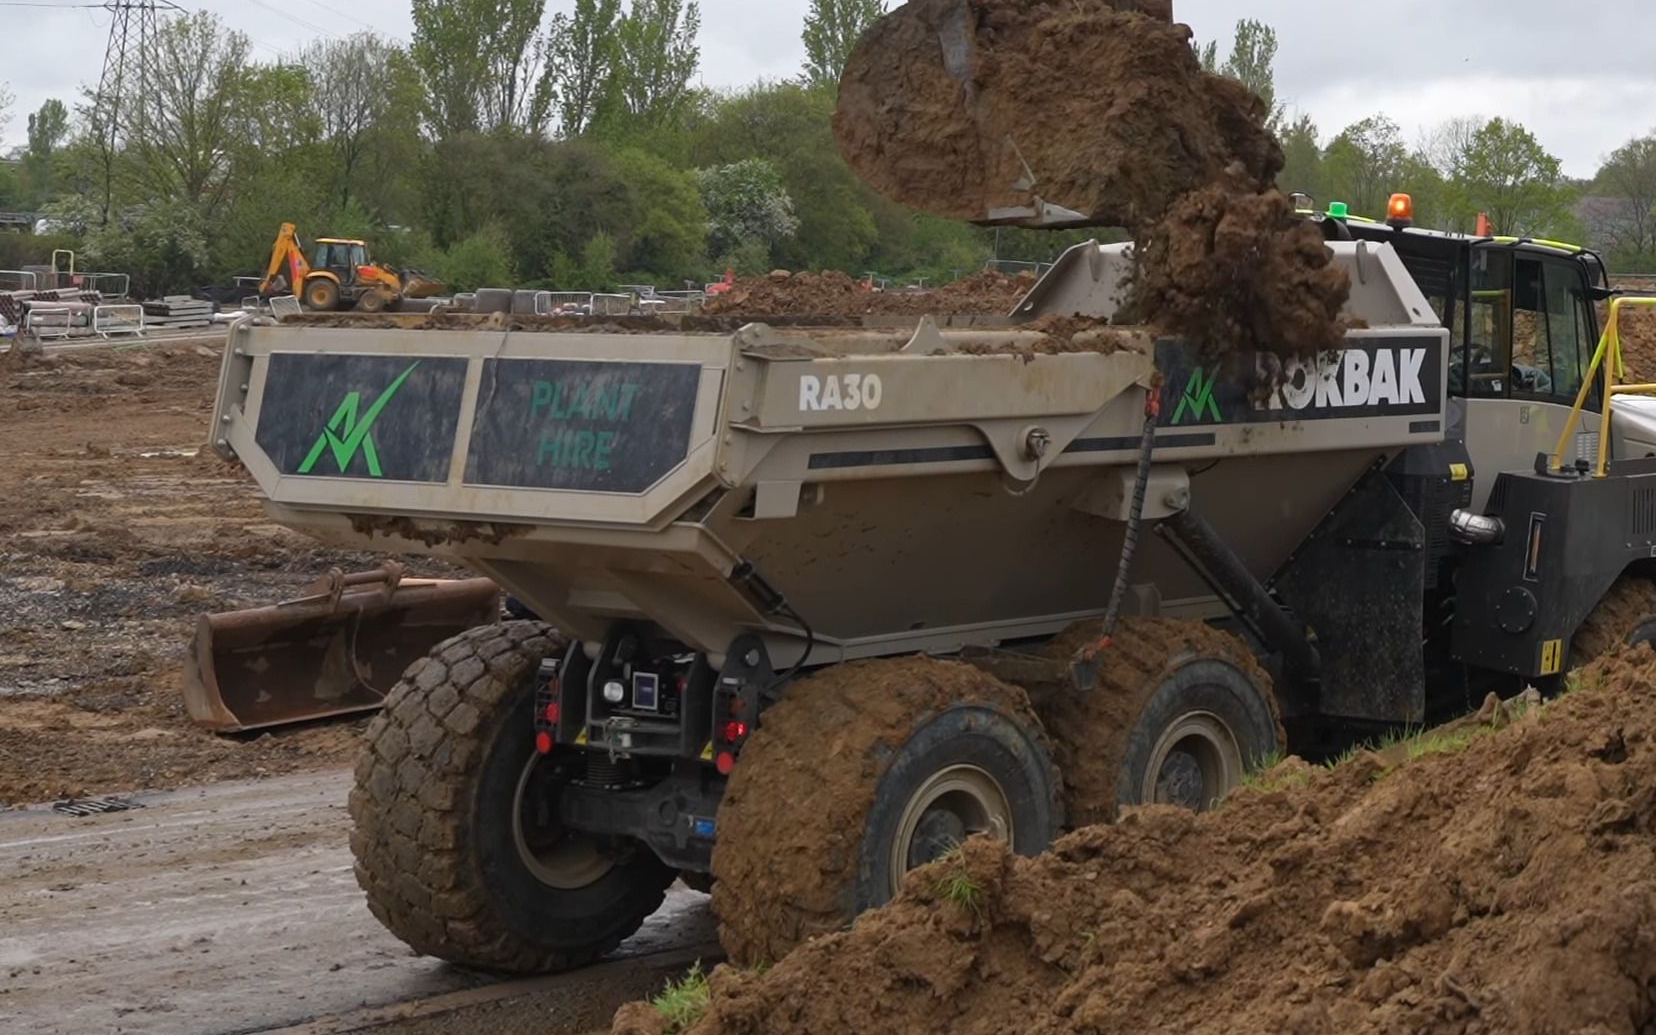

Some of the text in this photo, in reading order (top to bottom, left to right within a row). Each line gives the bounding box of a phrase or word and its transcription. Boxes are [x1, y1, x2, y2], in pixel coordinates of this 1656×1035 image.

[531, 380, 642, 422] PLANT
[799, 373, 883, 411] RA30
[537, 429, 615, 471] HIRE
